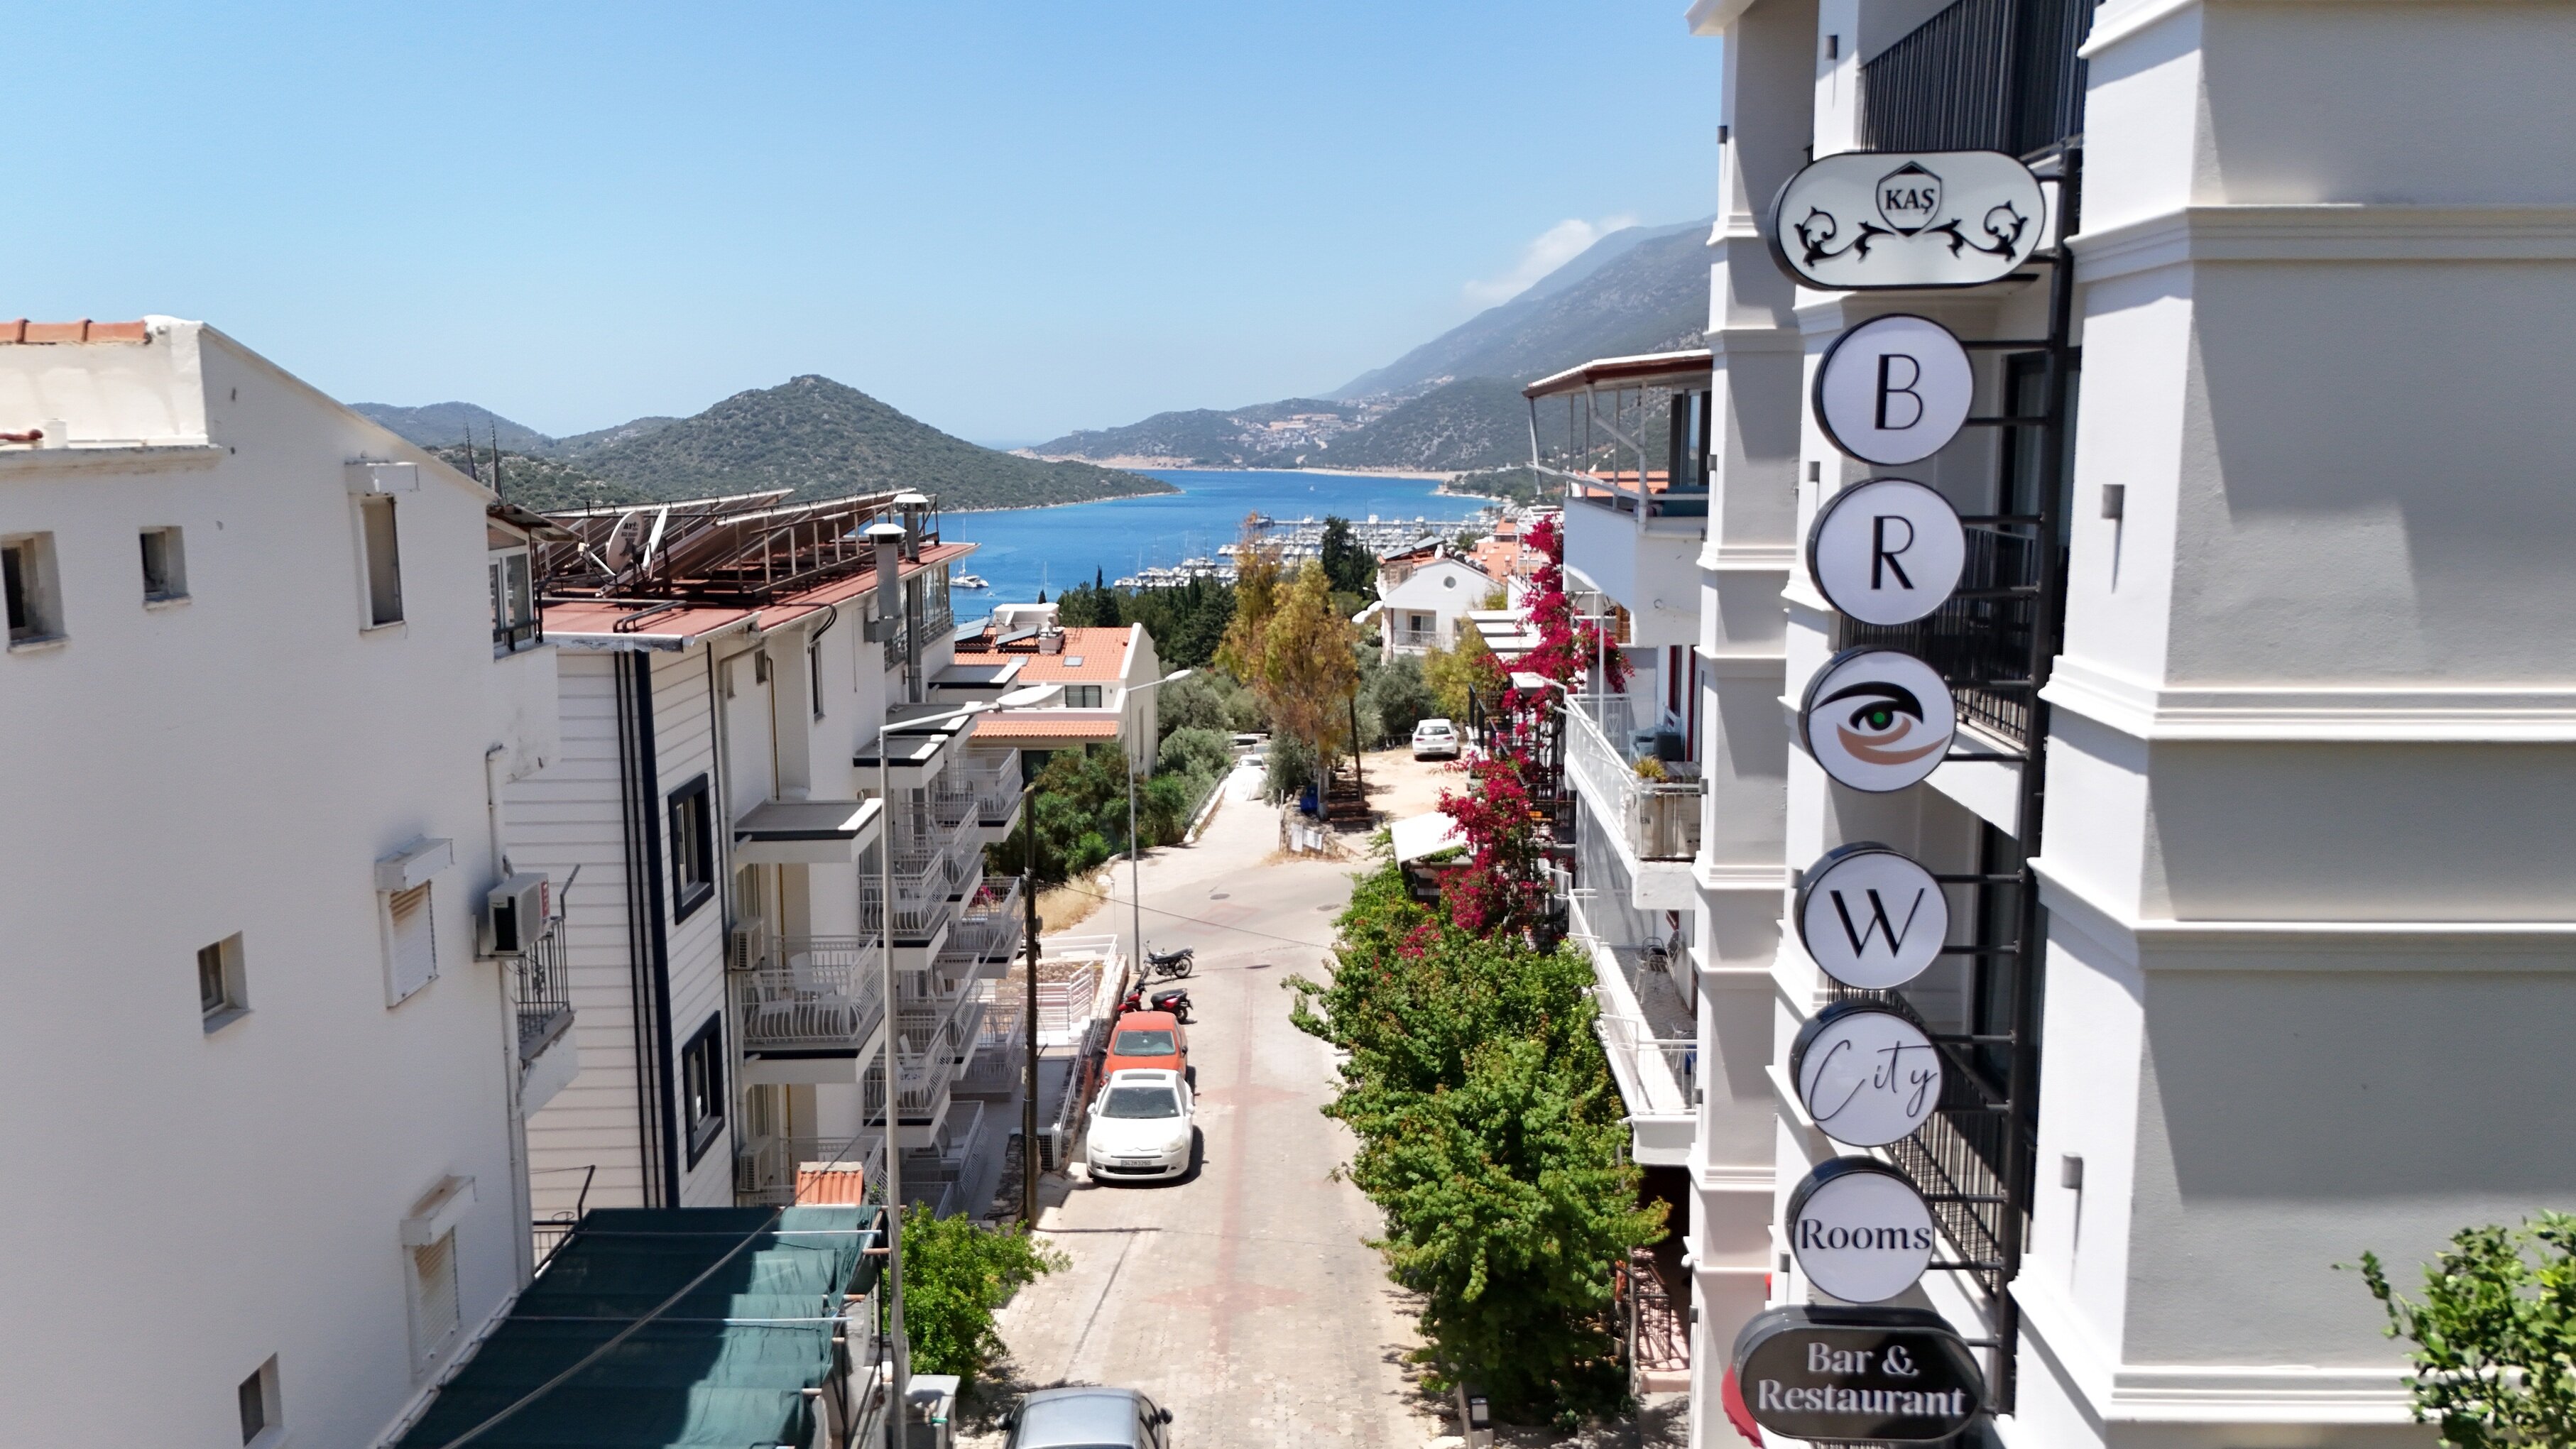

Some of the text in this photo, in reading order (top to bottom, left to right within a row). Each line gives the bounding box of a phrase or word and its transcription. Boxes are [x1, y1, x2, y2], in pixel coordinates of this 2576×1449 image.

[1884, 187, 1936, 216] KAŞ
[1874, 353, 1924, 431] B
[1870, 515, 1916, 591] R
[1829, 887, 1926, 959] W
[1808, 1039, 1938, 1122] City
[1801, 1218, 1932, 1250] Rooms
[1807, 1342, 1919, 1376] Bar &
[1757, 1379, 1965, 1416] Restaurant
